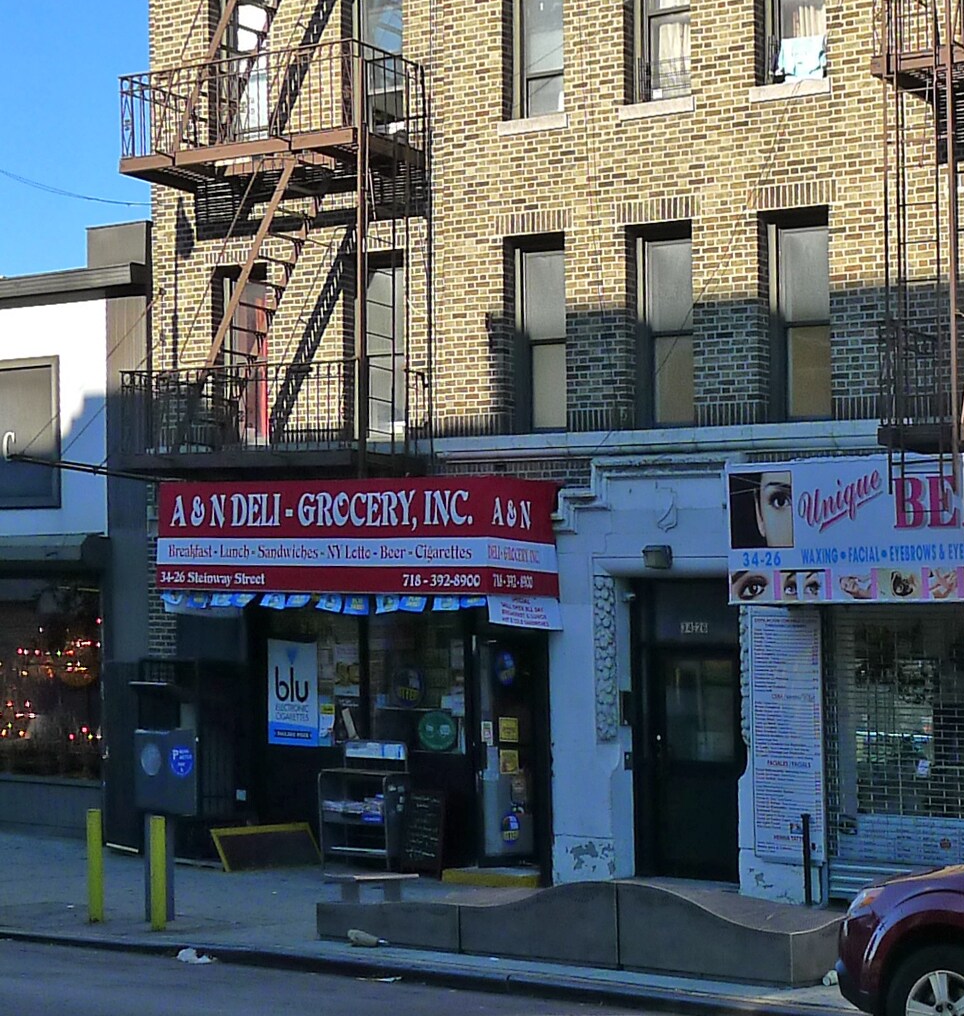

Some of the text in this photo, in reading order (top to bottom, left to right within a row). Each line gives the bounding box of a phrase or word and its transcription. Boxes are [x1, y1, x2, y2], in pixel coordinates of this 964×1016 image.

[170, 495, 187, 527] A
[190, 495, 206, 527] &
[209, 494, 227, 528] N
[230, 493, 281, 527] DELI
[297, 489, 417, 531] GROCERY,
[423, 489, 473, 527] INC.
[798, 469, 882, 530] Unique
[491, 496, 531, 531] A & N
[168, 544, 212, 560] Breakfast
[220, 544, 250, 560] Lunch
[257, 543, 319, 560] Sandwiches
[327, 544, 343, 559] NY
[345, 544, 371, 560] Lotto
[380, 544, 406, 560] Beer
[415, 543, 472, 563] Cigarettes
[743, 552, 782, 567] 34-26
[801, 547, 839, 565] WAXING
[848, 546, 881, 563] FACIAL
[890, 544, 937, 562] EYEBROWS
[938, 544, 945, 561] &
[160, 571, 266, 587] 34-26 Steinway Street
[403, 574, 421, 587] 718
[429, 573, 481, 588] 392-8900
[275, 666, 309, 703] blu
